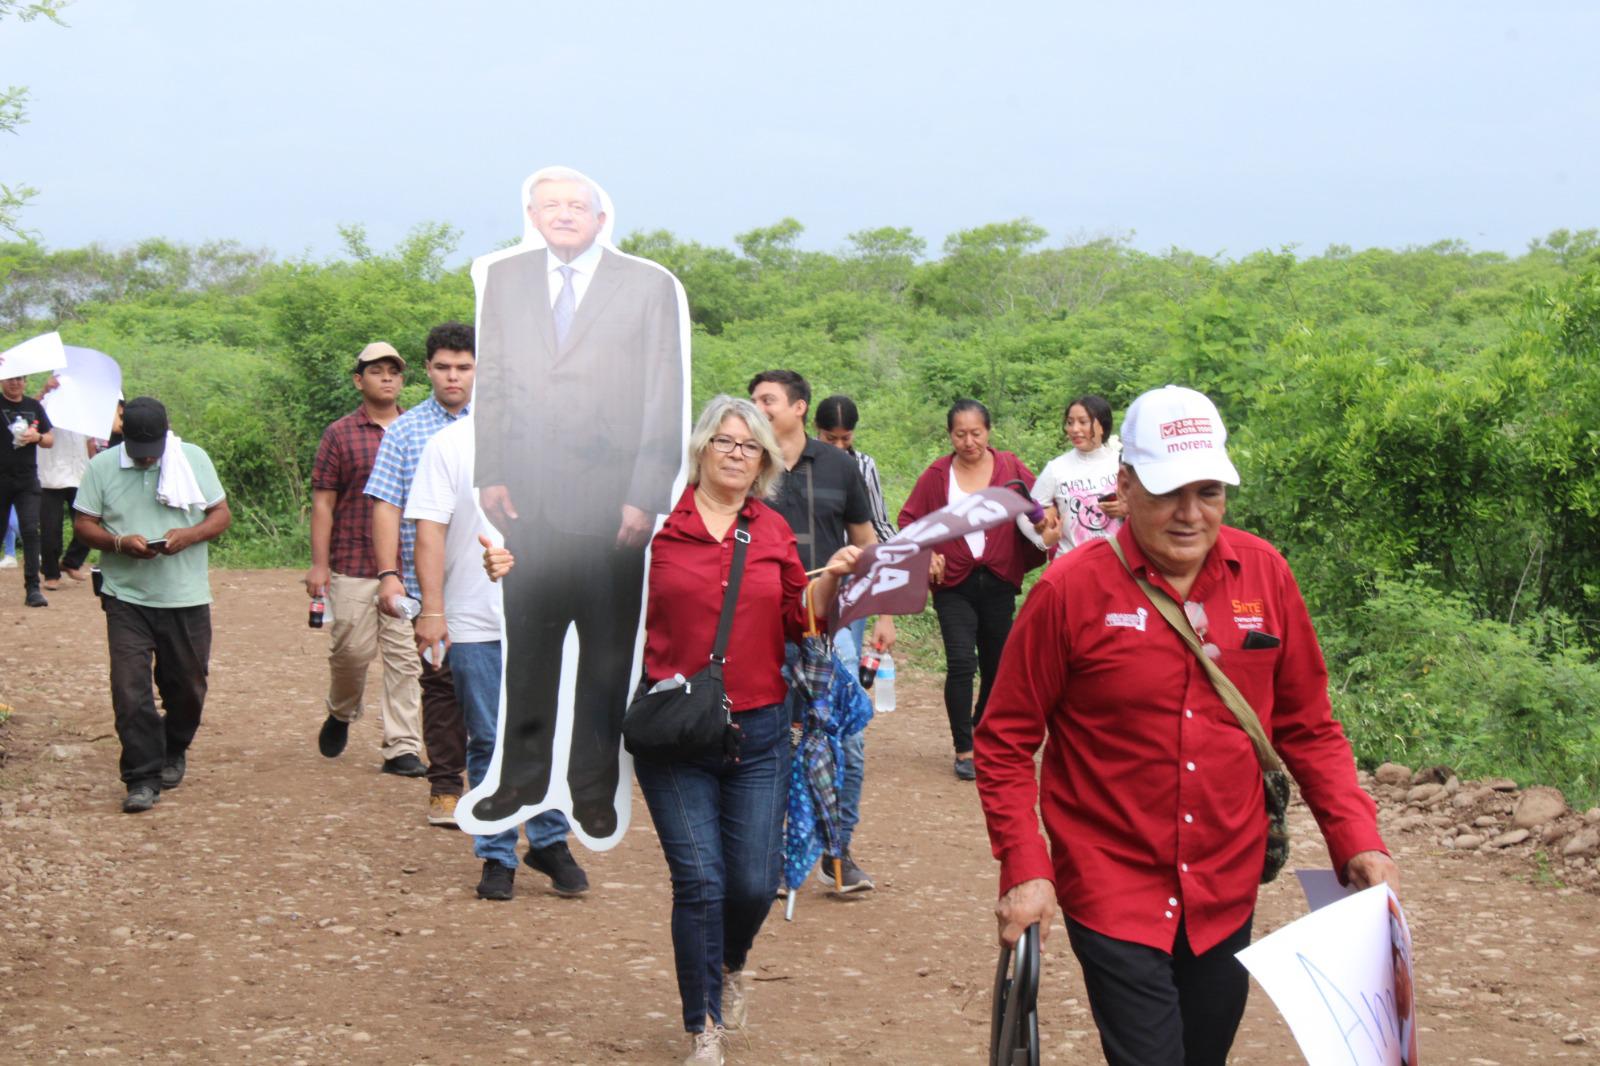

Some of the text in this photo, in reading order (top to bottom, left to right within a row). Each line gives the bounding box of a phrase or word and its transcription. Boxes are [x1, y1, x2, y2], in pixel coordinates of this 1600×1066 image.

[1178, 426, 1197, 434] VOTA
[1167, 439, 1213, 453] morena
[1100, 473, 1117, 488] OU
